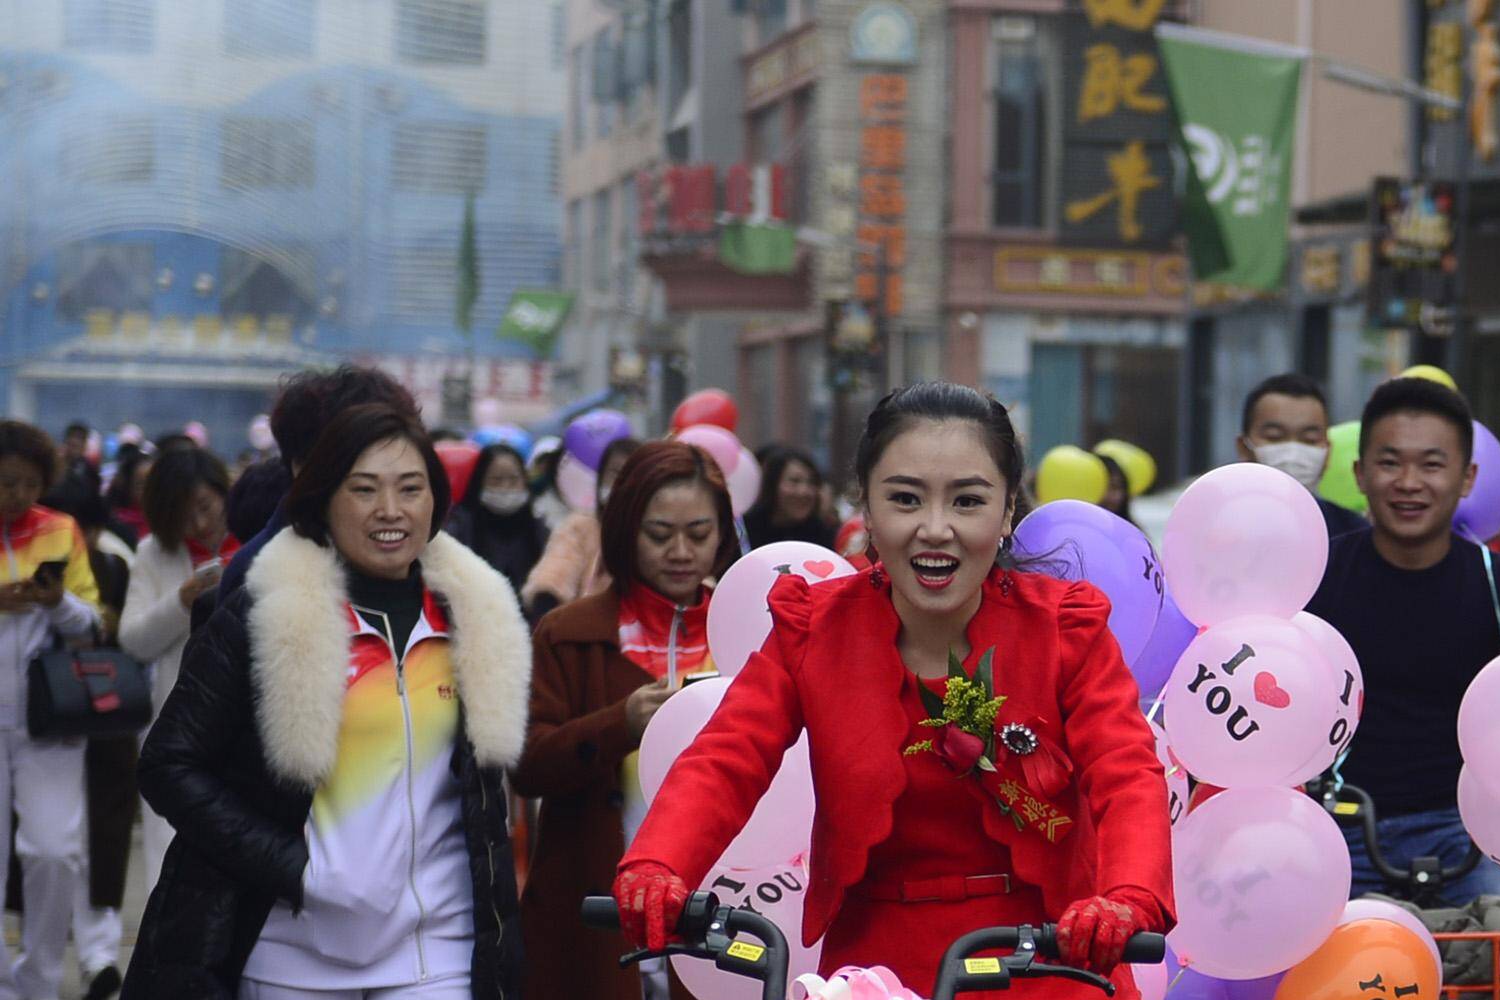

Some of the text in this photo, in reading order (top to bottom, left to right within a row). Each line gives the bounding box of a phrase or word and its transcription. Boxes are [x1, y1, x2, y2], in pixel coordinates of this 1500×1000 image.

[1222, 643, 1256, 676] I
[1187, 663, 1260, 741] YOU
[1339, 669, 1355, 706] I
[998, 778, 1050, 822] 新娘
[711, 874, 746, 894] I
[738, 872, 803, 916] YOU
[1394, 983, 1419, 999] I
